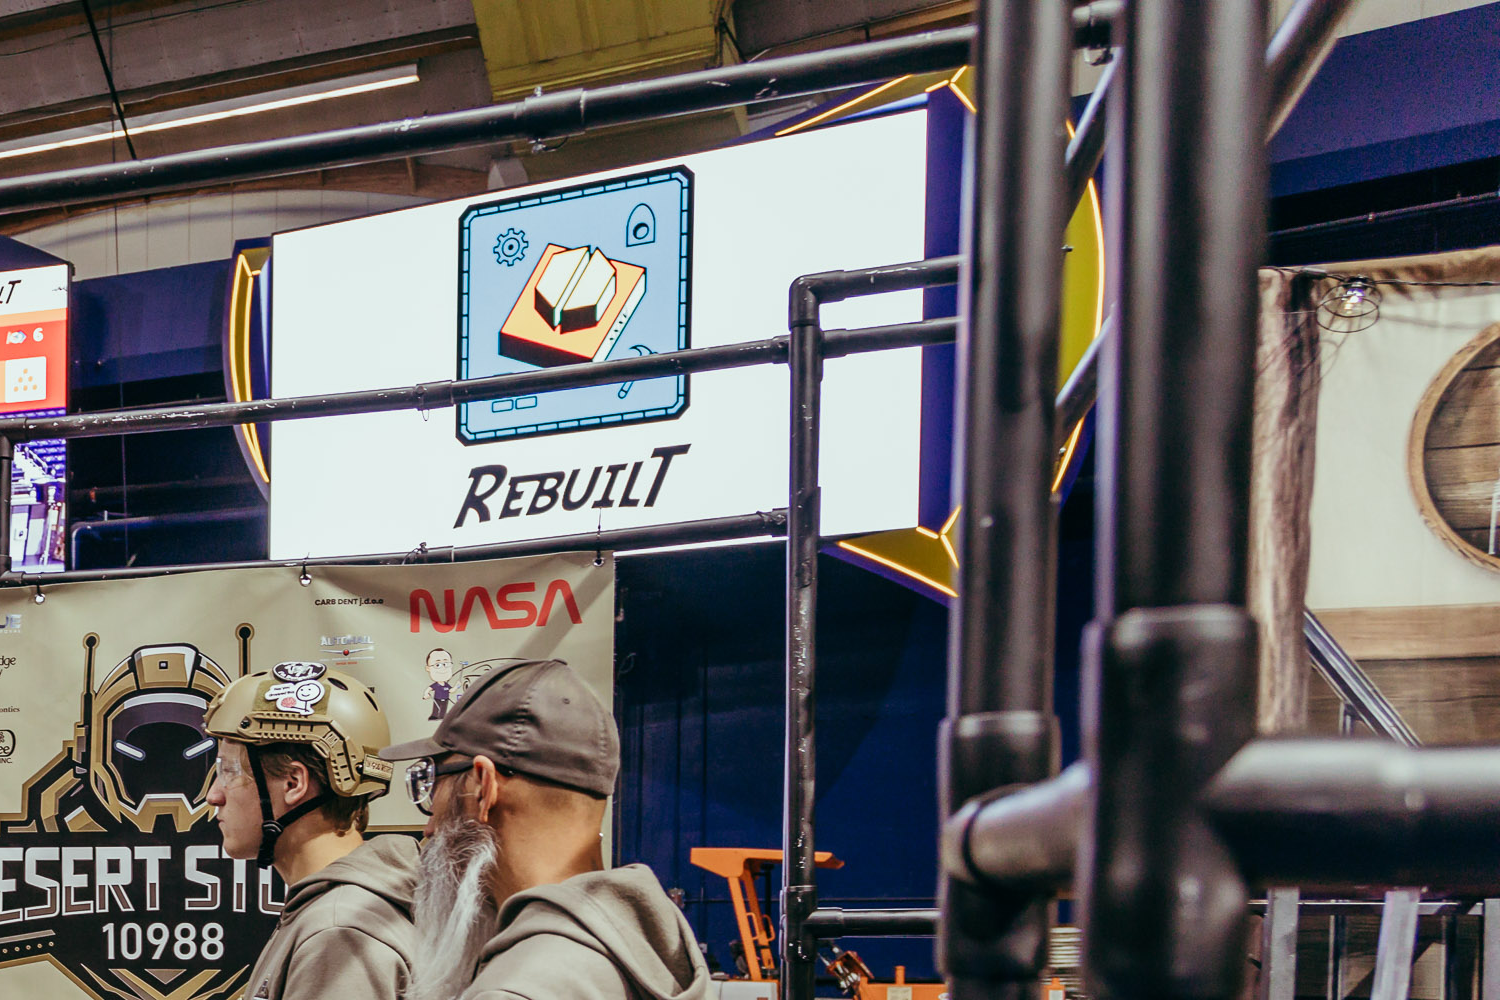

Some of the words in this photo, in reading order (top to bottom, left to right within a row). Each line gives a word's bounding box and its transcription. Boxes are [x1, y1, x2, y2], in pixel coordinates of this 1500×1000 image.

[33, 327, 44, 342] 6
[453, 443, 692, 529] REBUILT
[409, 579, 583, 634] NASA
[185, 845, 289, 916] STO
[102, 922, 224, 960] 10988
